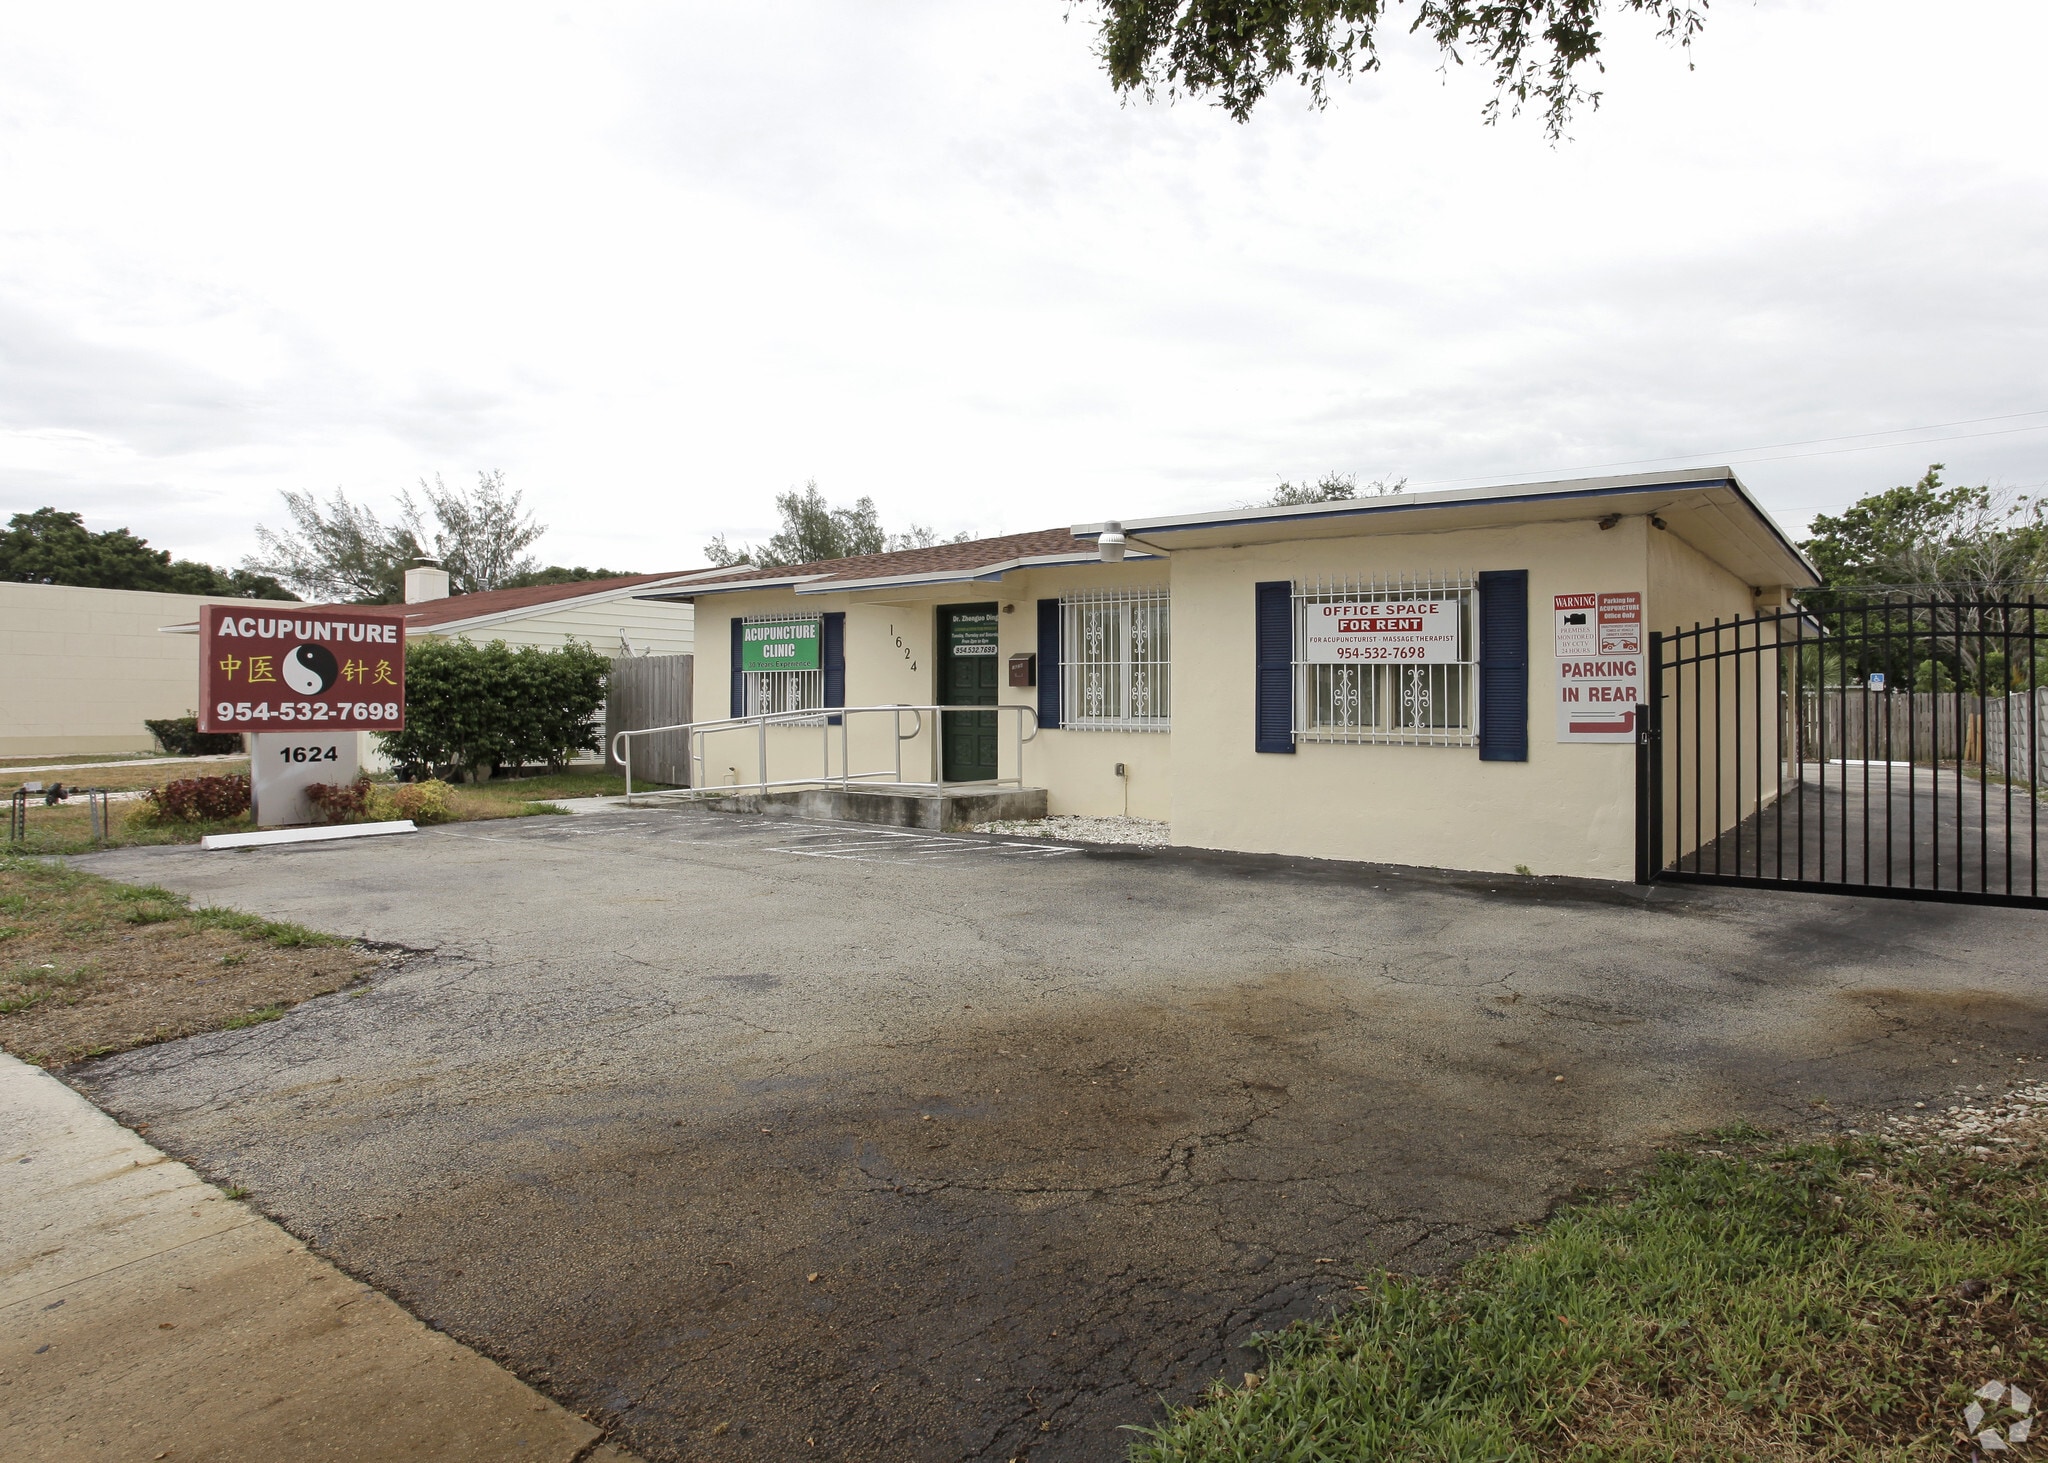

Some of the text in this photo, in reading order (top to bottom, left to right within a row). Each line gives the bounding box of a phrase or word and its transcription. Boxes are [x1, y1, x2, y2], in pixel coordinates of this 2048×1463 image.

[1555, 596, 1595, 607] WARNING
[1599, 604, 1640, 612] ACUPUNCTURE
[1323, 603, 1439, 617] OFFICE SPACE
[218, 616, 397, 644] ACUPUNTURE
[1339, 618, 1421, 631] FOR RENT
[744, 624, 816, 642] ACUPUNCTURE
[763, 643, 795, 658] CLINIC
[890, 624, 917, 671] 1624
[1337, 646, 1425, 659] 954-532-7698
[219, 653, 398, 685] 中医 针灸
[775, 660, 811, 669] Experience
[1562, 660, 1637, 678] PARKING
[1562, 686, 1637, 702] IN REAR
[217, 702, 399, 721] 954-532-7698
[280, 746, 338, 763] 1624
